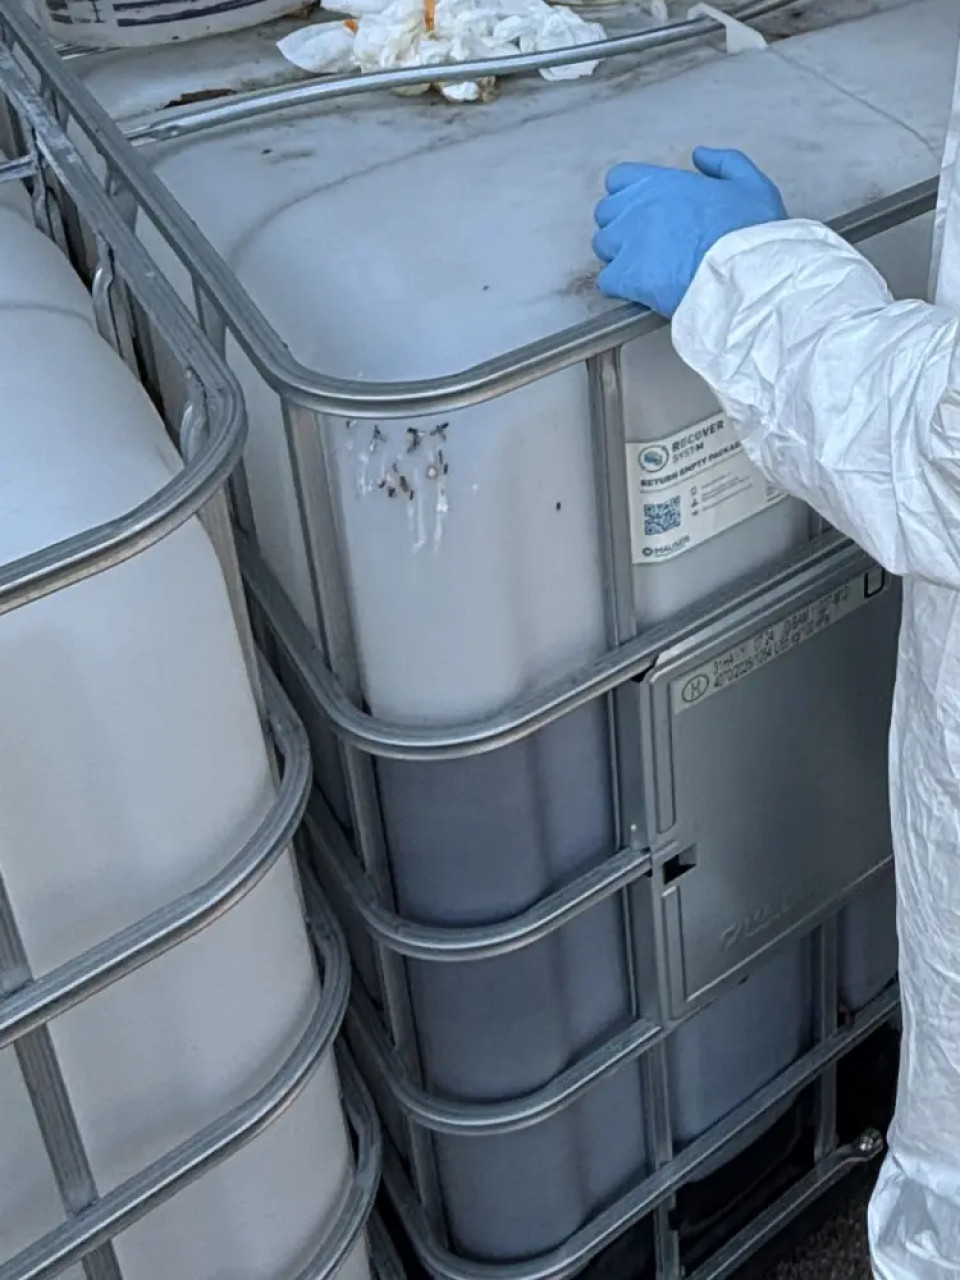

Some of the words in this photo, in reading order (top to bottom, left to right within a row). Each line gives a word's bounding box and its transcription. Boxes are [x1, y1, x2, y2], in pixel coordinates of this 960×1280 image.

[671, 420, 724, 453] RECOVER
[640, 471, 678, 487] RETURN
[679, 457, 707, 475] EMPTY
